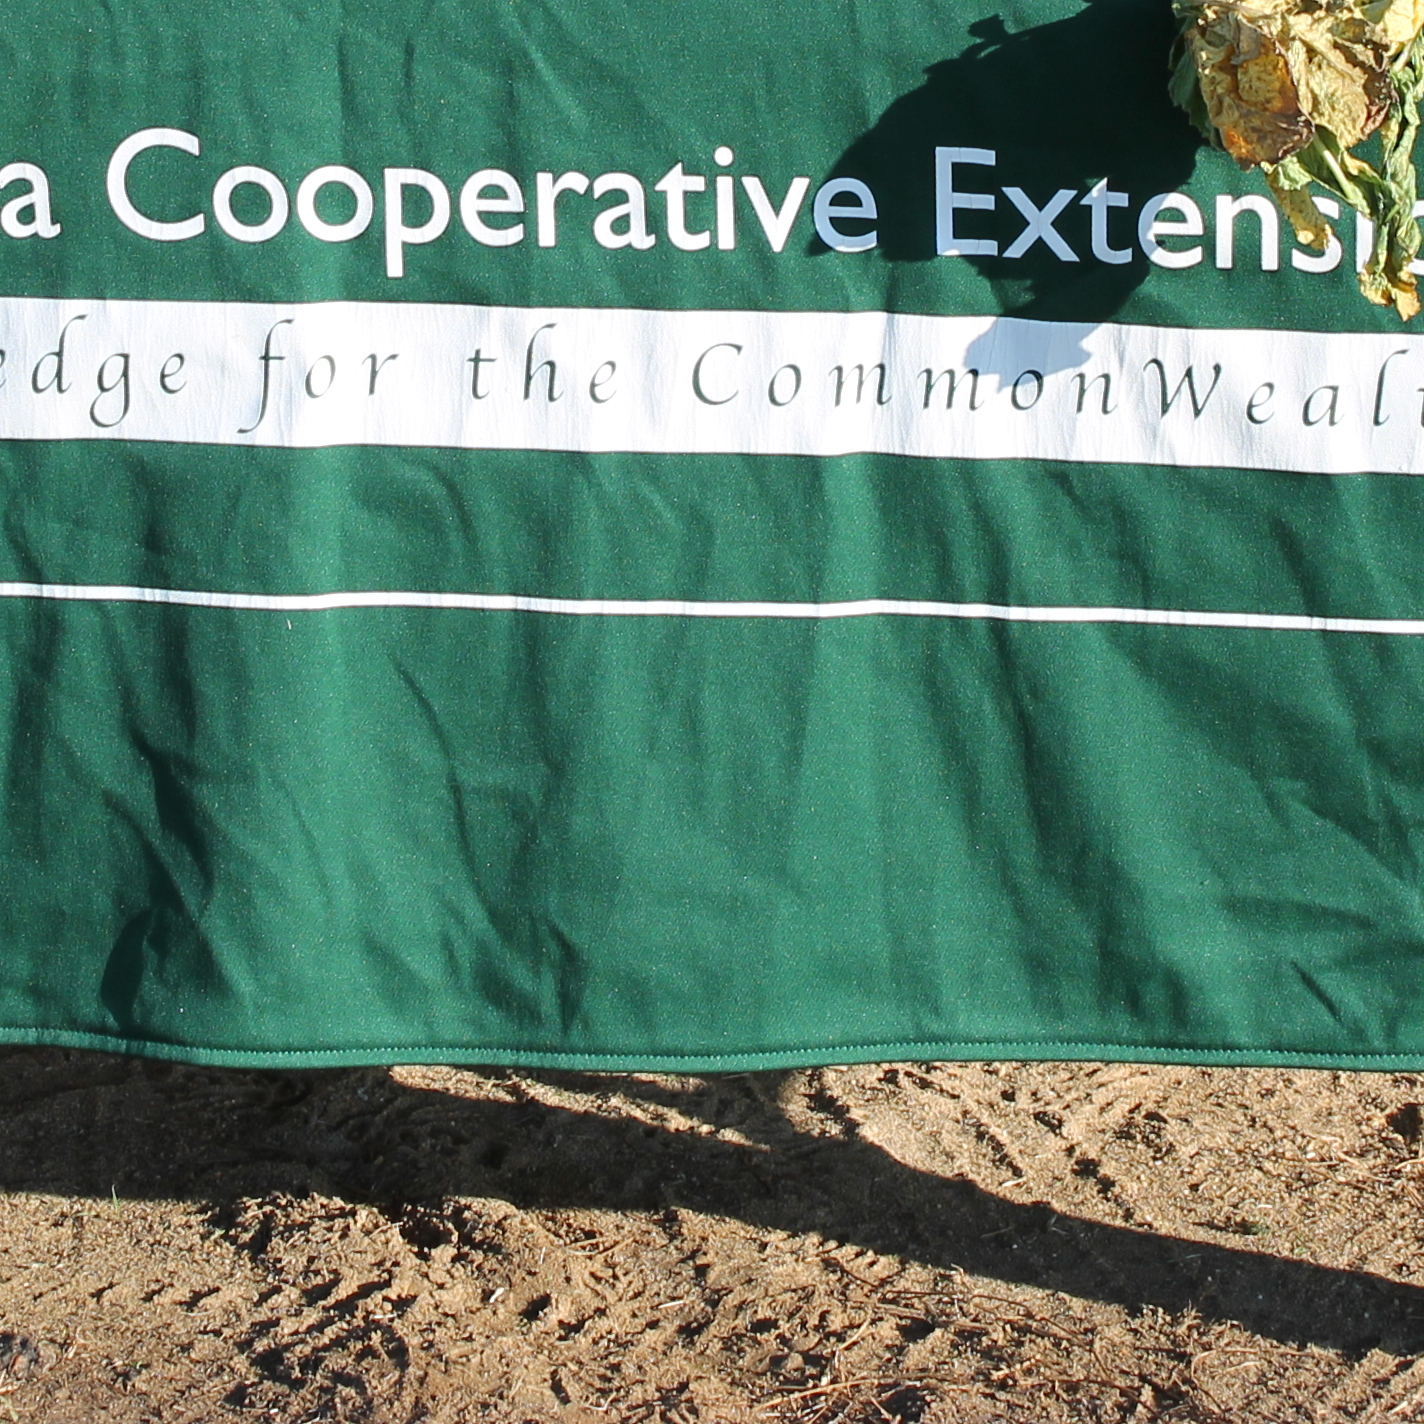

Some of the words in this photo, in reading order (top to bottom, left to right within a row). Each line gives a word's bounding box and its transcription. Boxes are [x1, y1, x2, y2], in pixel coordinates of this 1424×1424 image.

[106, 127, 878, 279] Cooperative
[237, 319, 399, 434] for
[467, 323, 618, 404] the
